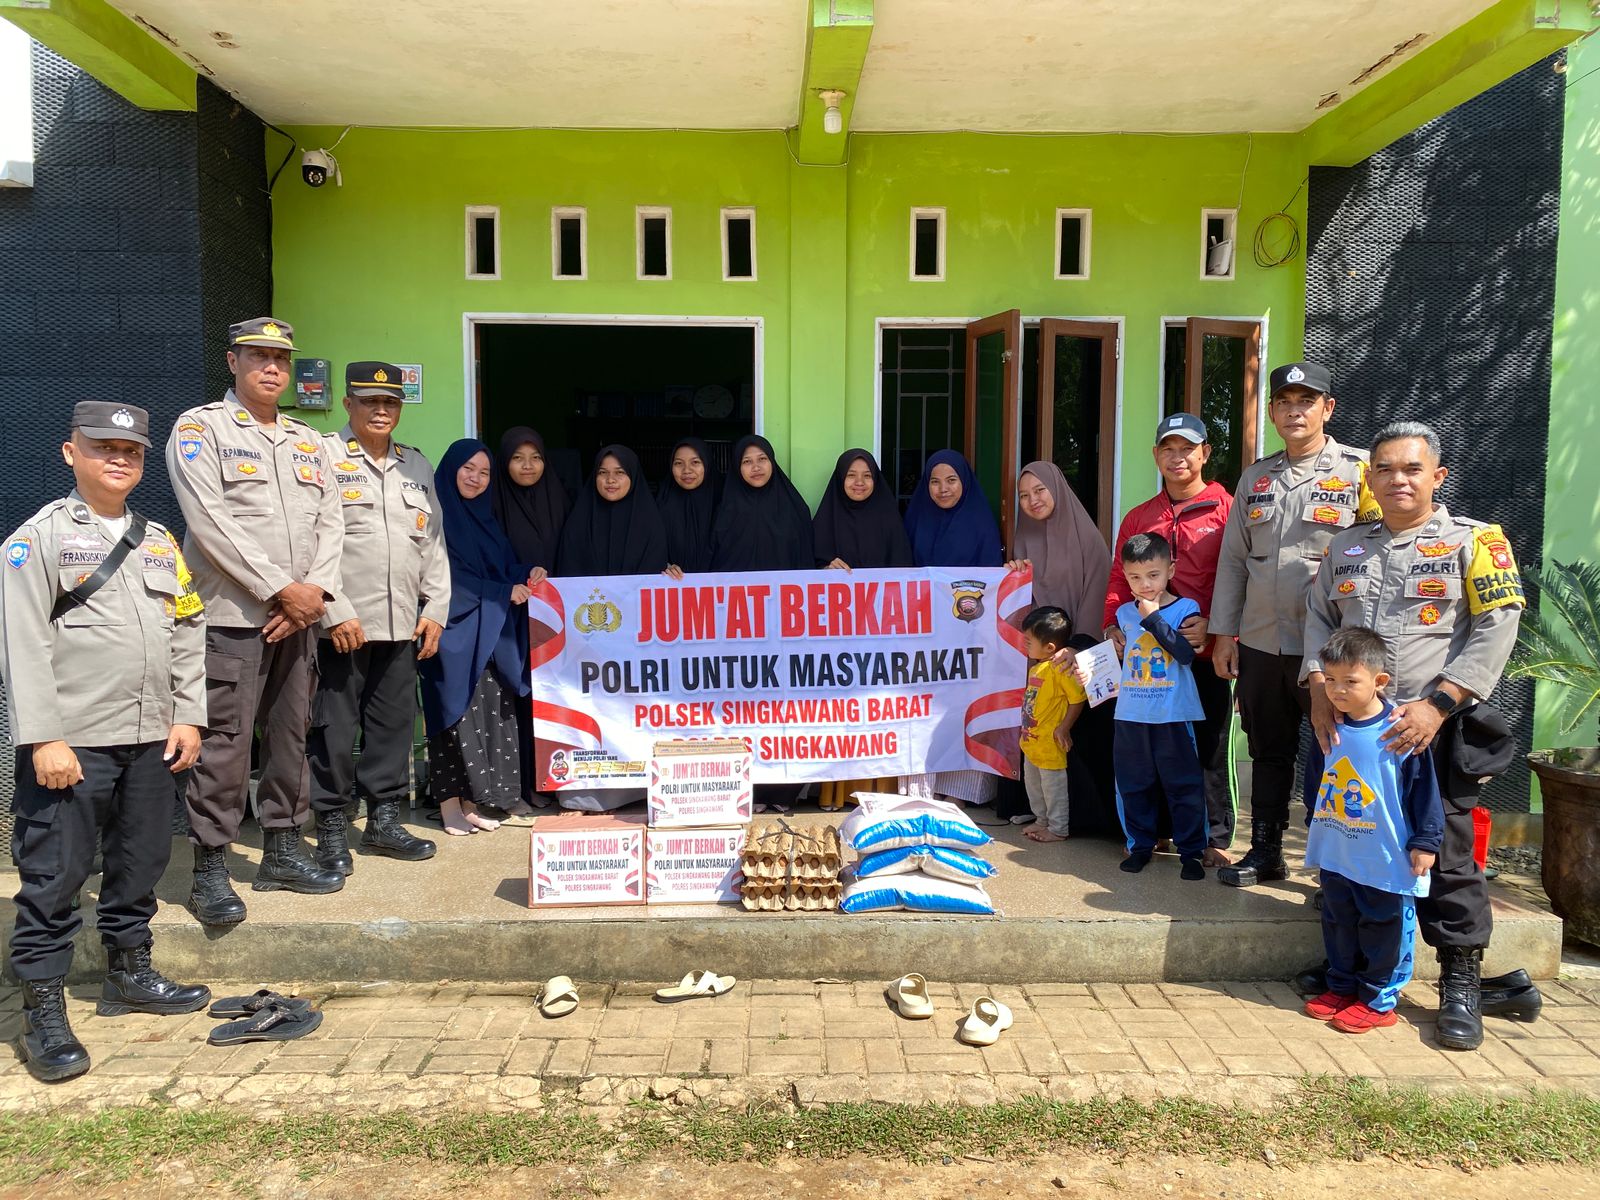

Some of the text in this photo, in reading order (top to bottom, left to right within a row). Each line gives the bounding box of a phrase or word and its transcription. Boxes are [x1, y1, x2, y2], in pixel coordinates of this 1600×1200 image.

[292, 453, 322, 468] POLRI
[1310, 491, 1351, 504] POLRI
[1334, 565, 1368, 577] ADIFIAR
[1410, 562, 1456, 575] POLRI
[638, 580, 933, 642] JUM'AT BERKAH
[581, 647, 984, 694] POLRI UNTUK MASYARAKAT
[634, 694, 933, 727] POLSEK SINGKAWANG BARAT
[759, 731, 898, 760] SINGKAWANG
[672, 761, 731, 780] JUM'AT BERKAH
[661, 781, 741, 795] POLRI UNTUK MASYARAKAT
[671, 796, 688, 804] POLSEK
[717, 794, 731, 802] BARAT
[558, 838, 619, 857] JUM'AT BERKAH
[665, 837, 725, 856] JUM'AT BERKAH
[546, 858, 629, 872] POLRI UNTUK MASYARAKAT
[654, 858, 736, 871] POLRI UNTUK MASYARAKAT
[604, 872, 619, 880] BARAT
